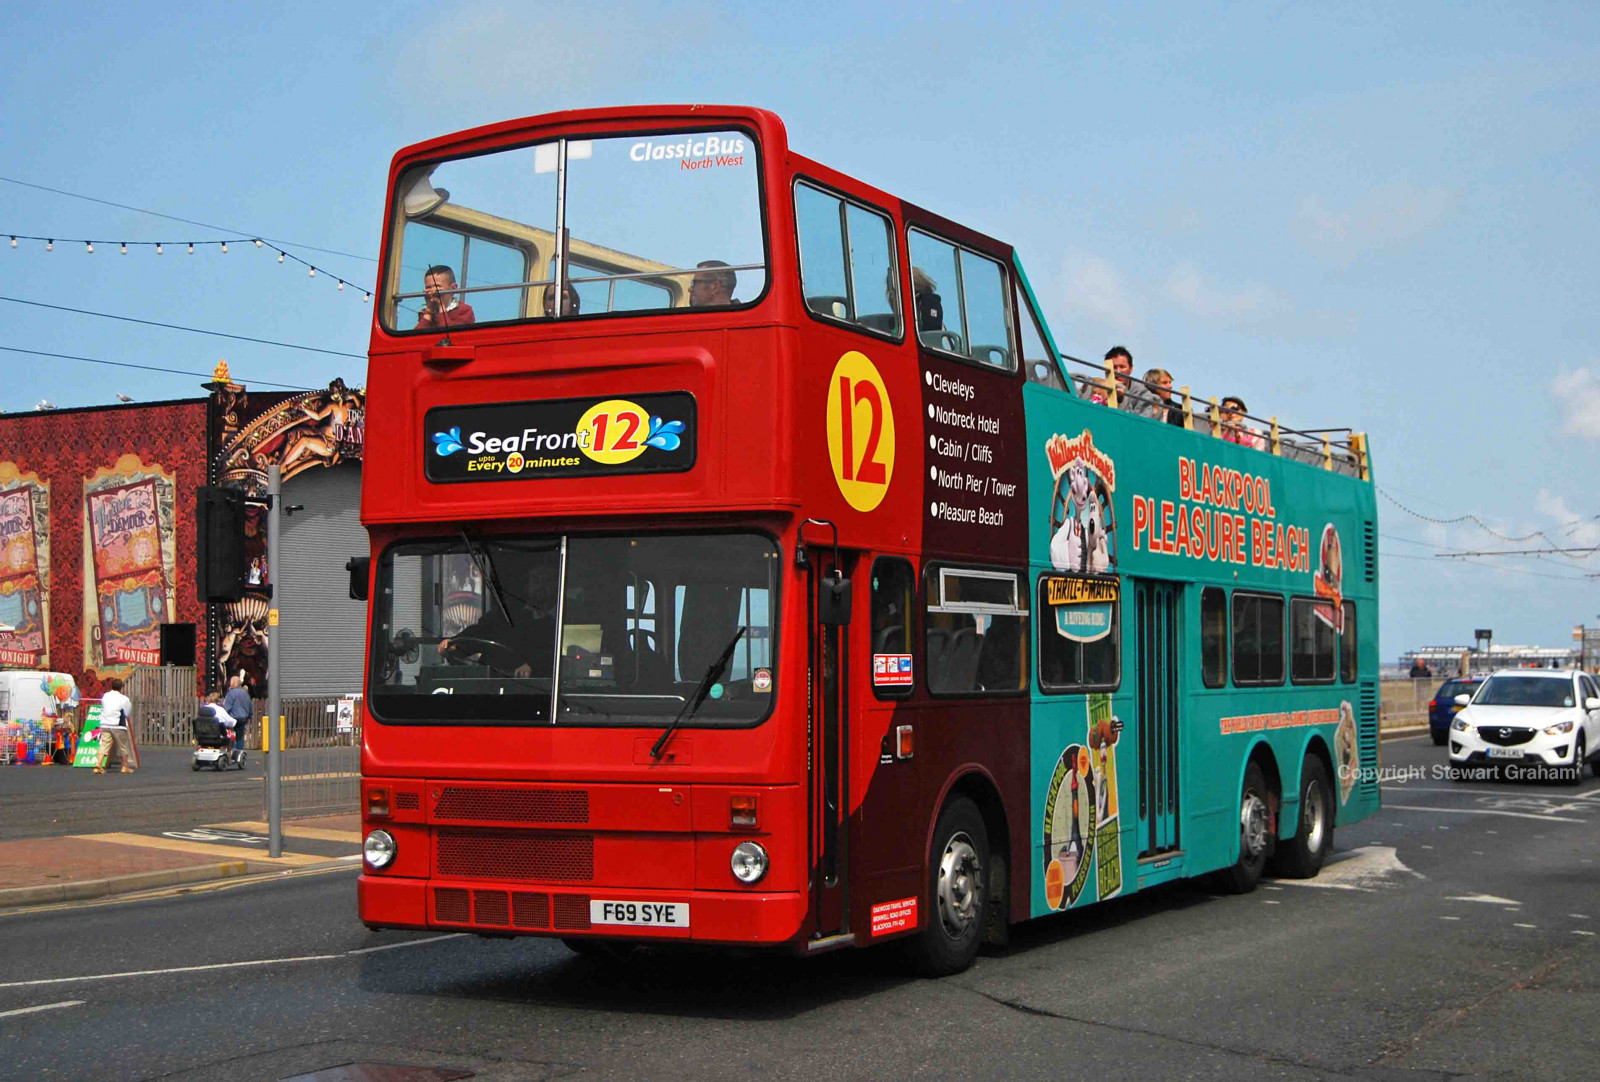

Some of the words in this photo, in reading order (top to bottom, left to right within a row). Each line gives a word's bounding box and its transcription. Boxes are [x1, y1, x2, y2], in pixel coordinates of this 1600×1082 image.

[630, 136, 745, 161] ClassicBus
[680, 157, 713, 171] North
[715, 155, 744, 167] West
[932, 374, 975, 402] Cleveleys
[467, 428, 590, 455] SeaFront
[590, 410, 642, 453] 12
[840, 376, 886, 485] 12
[936, 405, 975, 430] Norbreck
[977, 415, 1000, 435] Hotel
[478, 455, 496, 464] upto
[937, 438, 962, 458] Cabin
[964, 442, 970, 462] /
[971, 444, 993, 464] Cliffs
[467, 461, 506, 473] Every
[508, 457, 523, 469] 20
[525, 456, 580, 469] minutes
[938, 469, 963, 490] North
[965, 474, 983, 493] Pier
[983, 476, 990, 496] /
[991, 478, 1016, 497] Tower
[1178, 456, 1276, 518] BLACKPOOL
[939, 502, 976, 524] Pleasure
[978, 508, 1004, 526] Beach
[1133, 495, 1246, 564] PLEASURE
[1251, 518, 1309, 573] BEACH
[0, 649, 36, 665] ONIGHT
[118, 648, 160, 665] TONIGHT
[603, 903, 637, 921] F69
[641, 904, 676, 923] SYE
